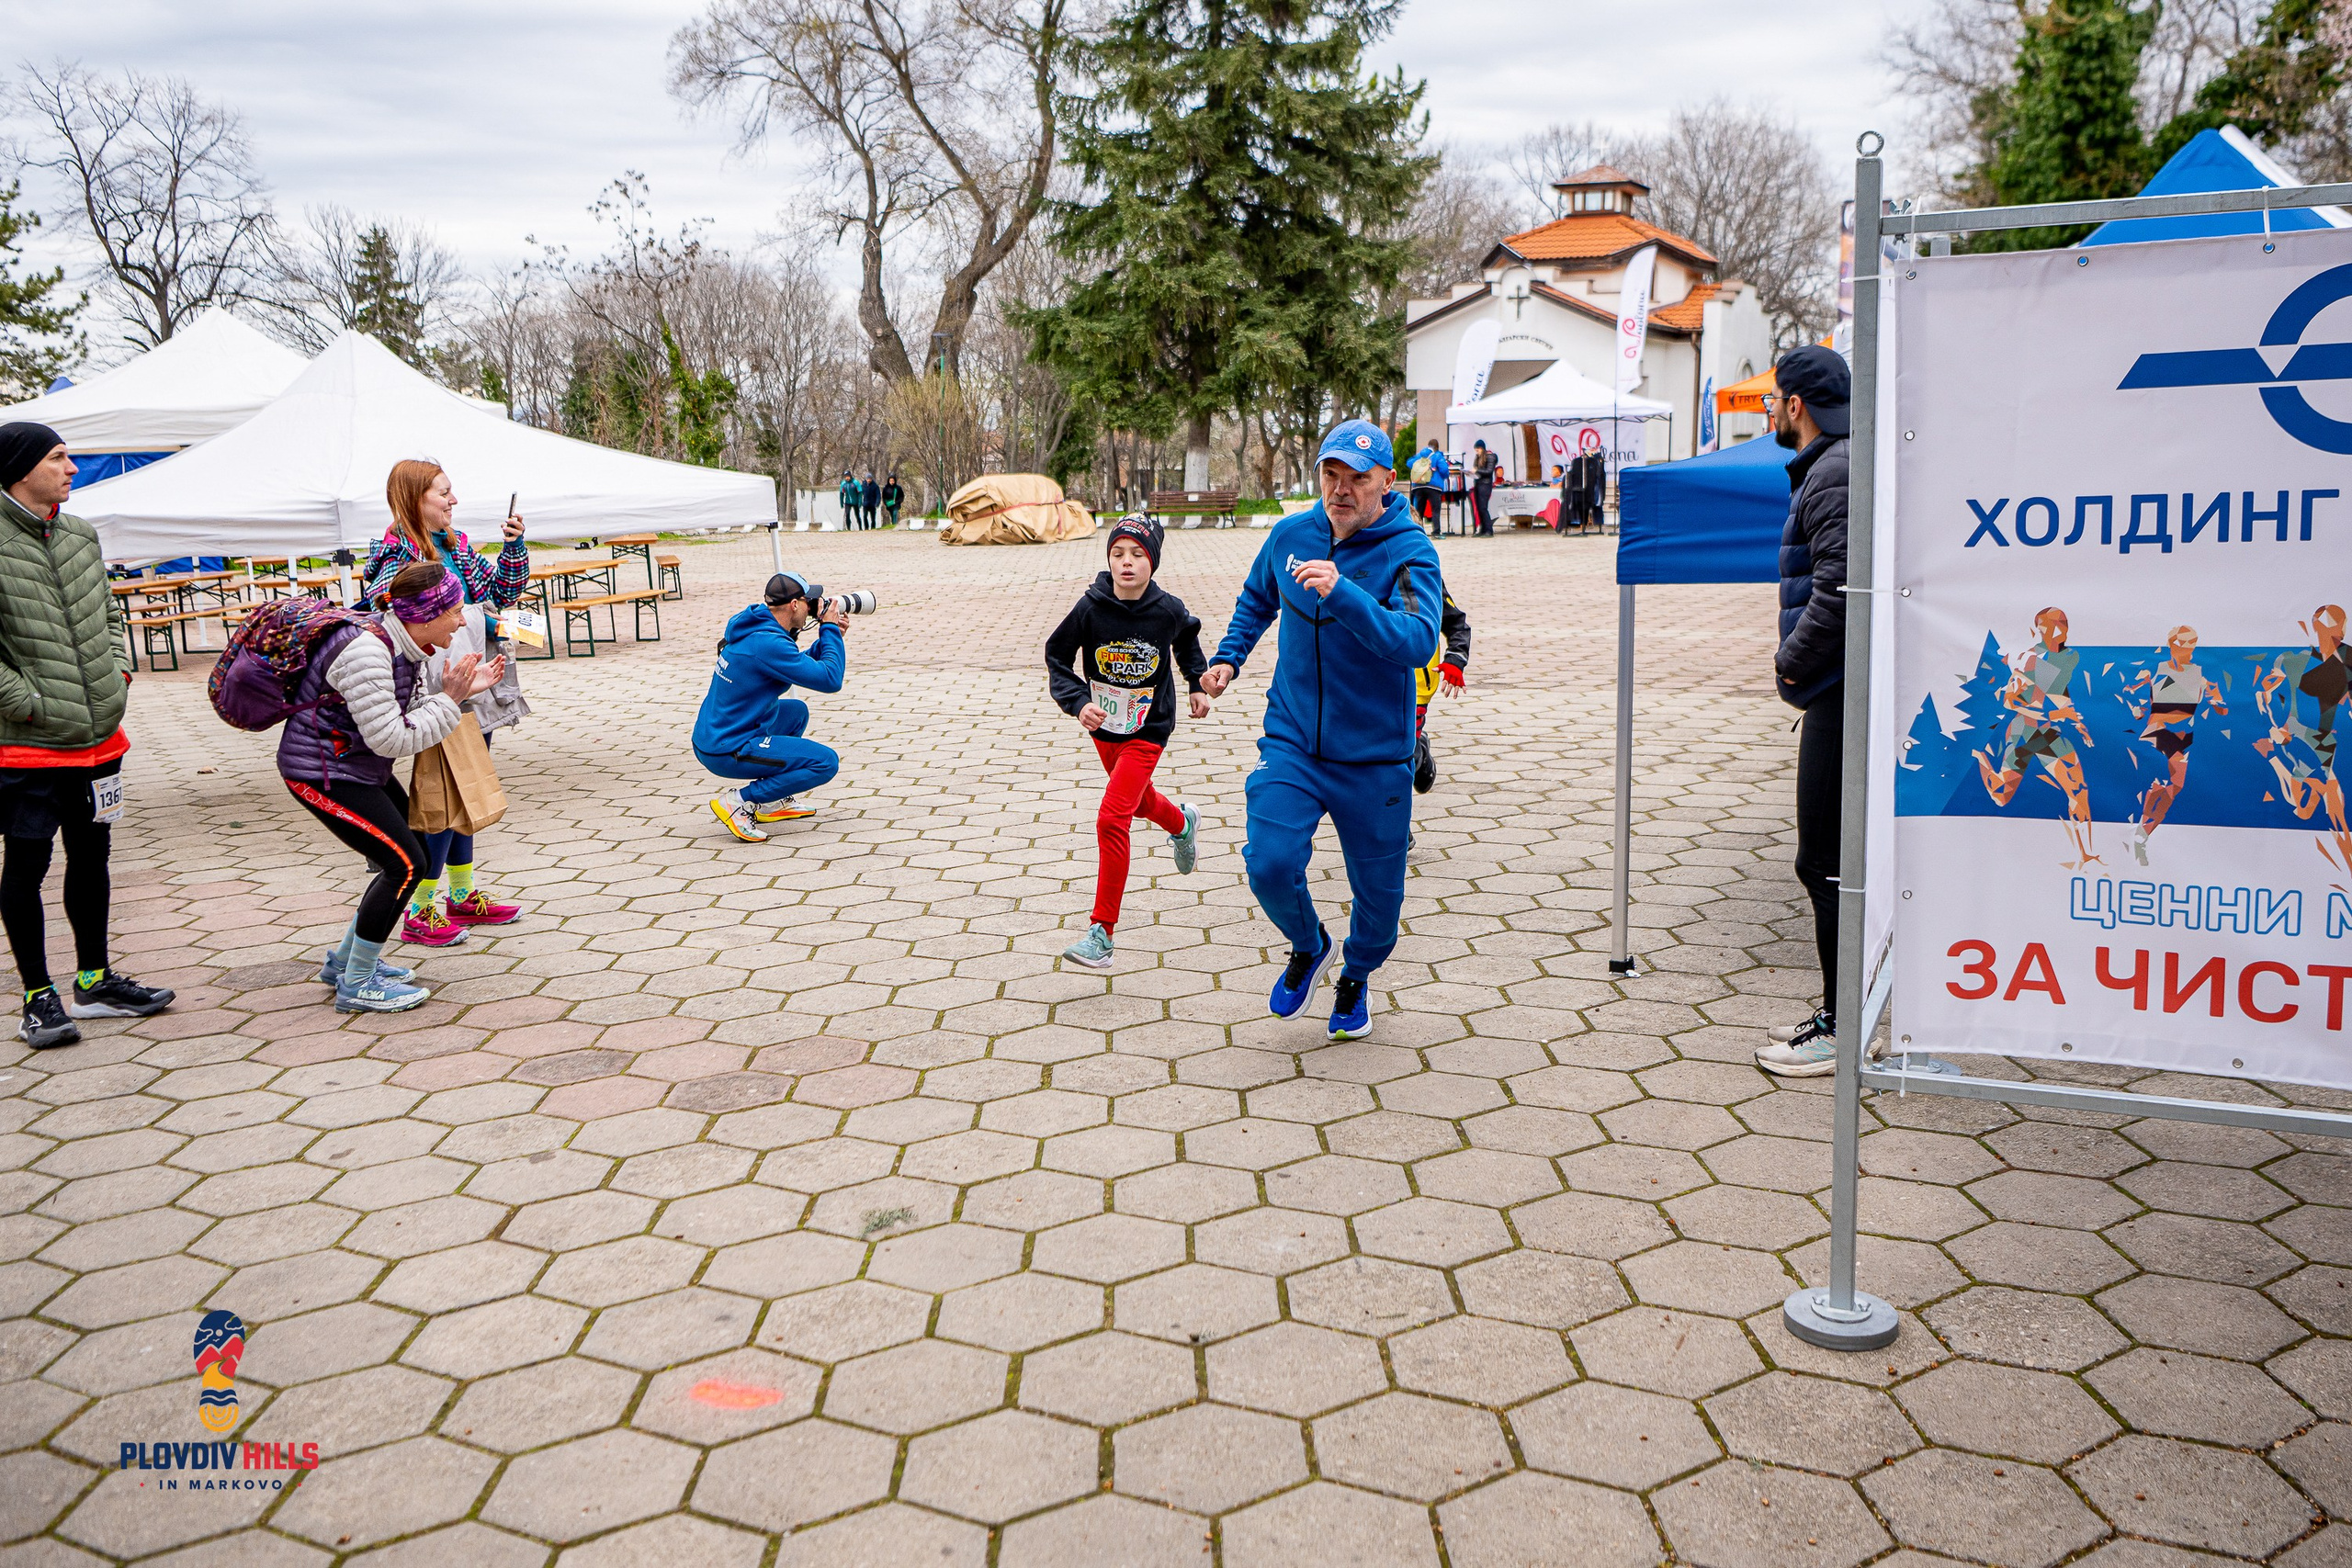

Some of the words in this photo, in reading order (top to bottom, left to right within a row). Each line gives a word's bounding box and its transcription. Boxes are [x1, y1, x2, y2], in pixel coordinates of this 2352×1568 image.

[1737, 394, 1758, 404] TRY
[1963, 488, 2340, 555] ХОЛДИНГ
[1101, 651, 1125, 662] FUN
[1113, 660, 1154, 674] PARK
[1098, 694, 1118, 716] 120
[2070, 877, 2302, 937] ЦЕННИ
[1945, 939, 2066, 1005] ЗА
[356, 988, 386, 1000] HOKA
